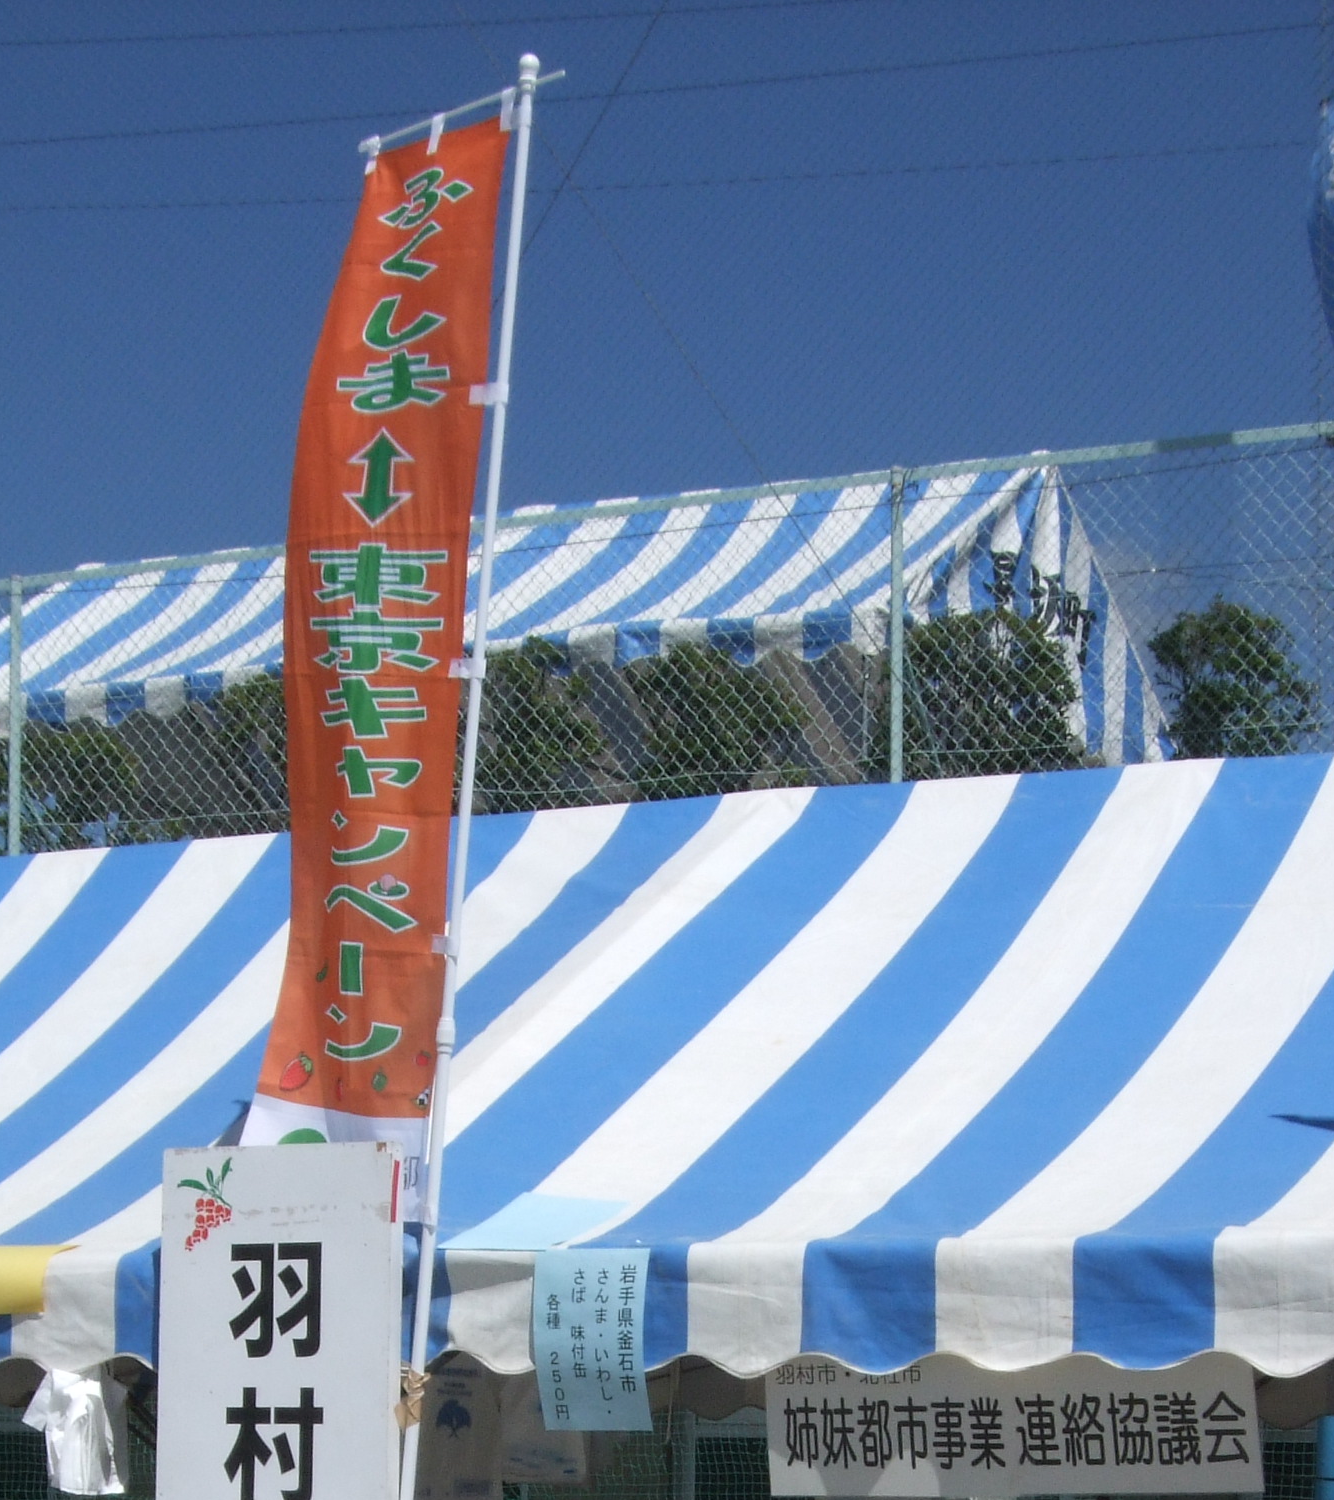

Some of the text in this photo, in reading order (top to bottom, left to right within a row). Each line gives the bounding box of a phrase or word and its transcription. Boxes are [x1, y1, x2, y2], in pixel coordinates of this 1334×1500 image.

[309, 165, 473, 1061] ふくしま 東京キャンペーン
[546, 1294, 570, 1419] 各種 250円
[570, 1268, 587, 1378] さば 味付缶
[616, 1263, 637, 1393] 岩手県釜石市
